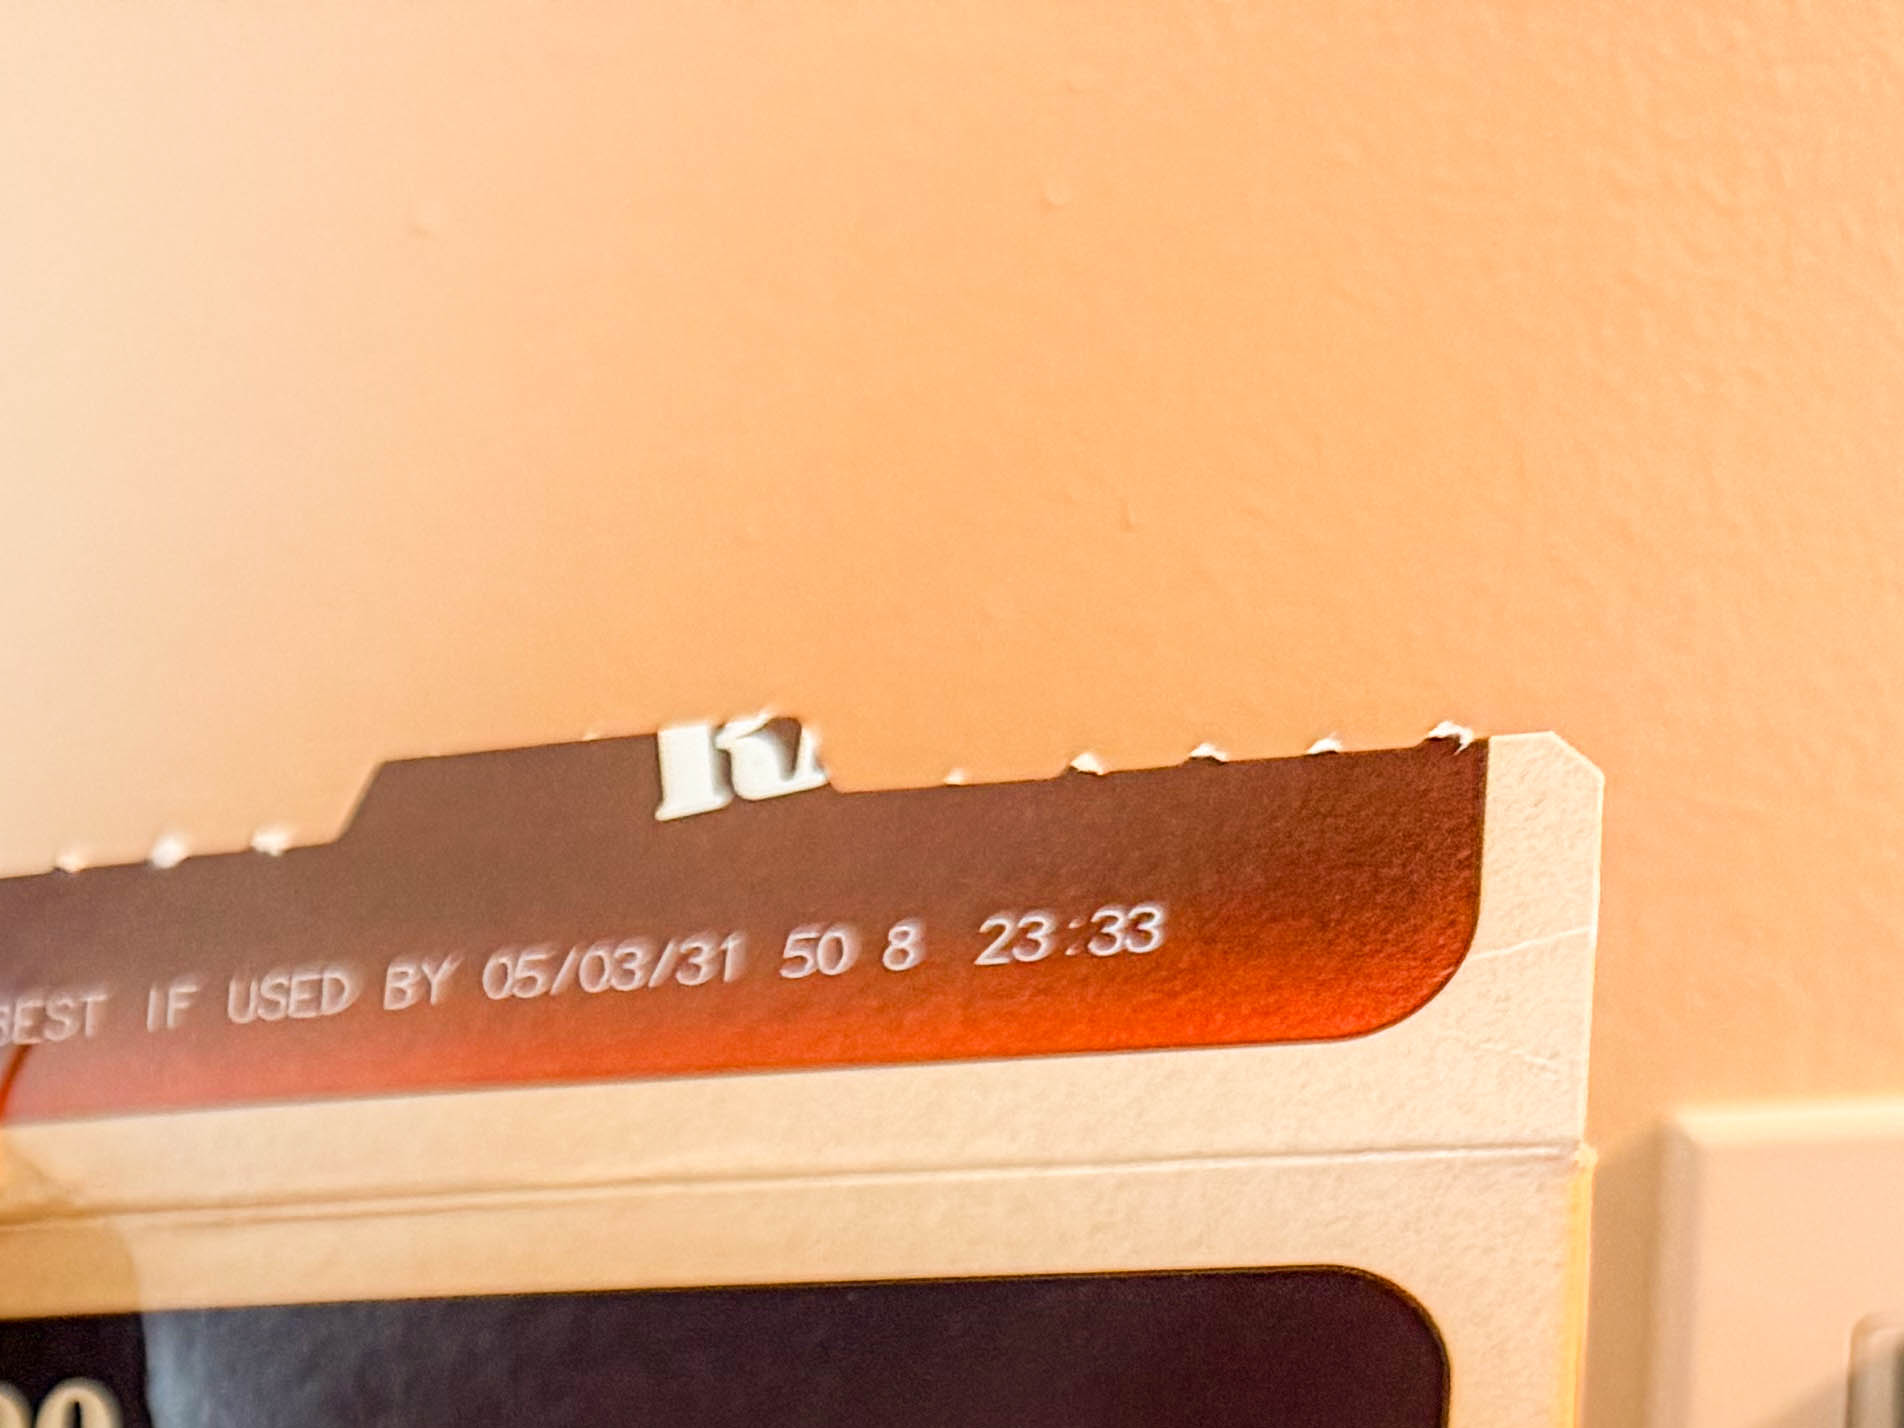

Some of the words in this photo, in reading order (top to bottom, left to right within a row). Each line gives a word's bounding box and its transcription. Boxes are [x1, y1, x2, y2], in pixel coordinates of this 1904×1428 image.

[146, 980, 201, 1033] IF
[227, 968, 359, 1024] USED
[383, 953, 461, 1011] BY
[482, 929, 746, 1000] 05/03/31
[779, 923, 859, 979] 50
[881, 918, 928, 972] 8
[974, 902, 1169, 967] 23:33
